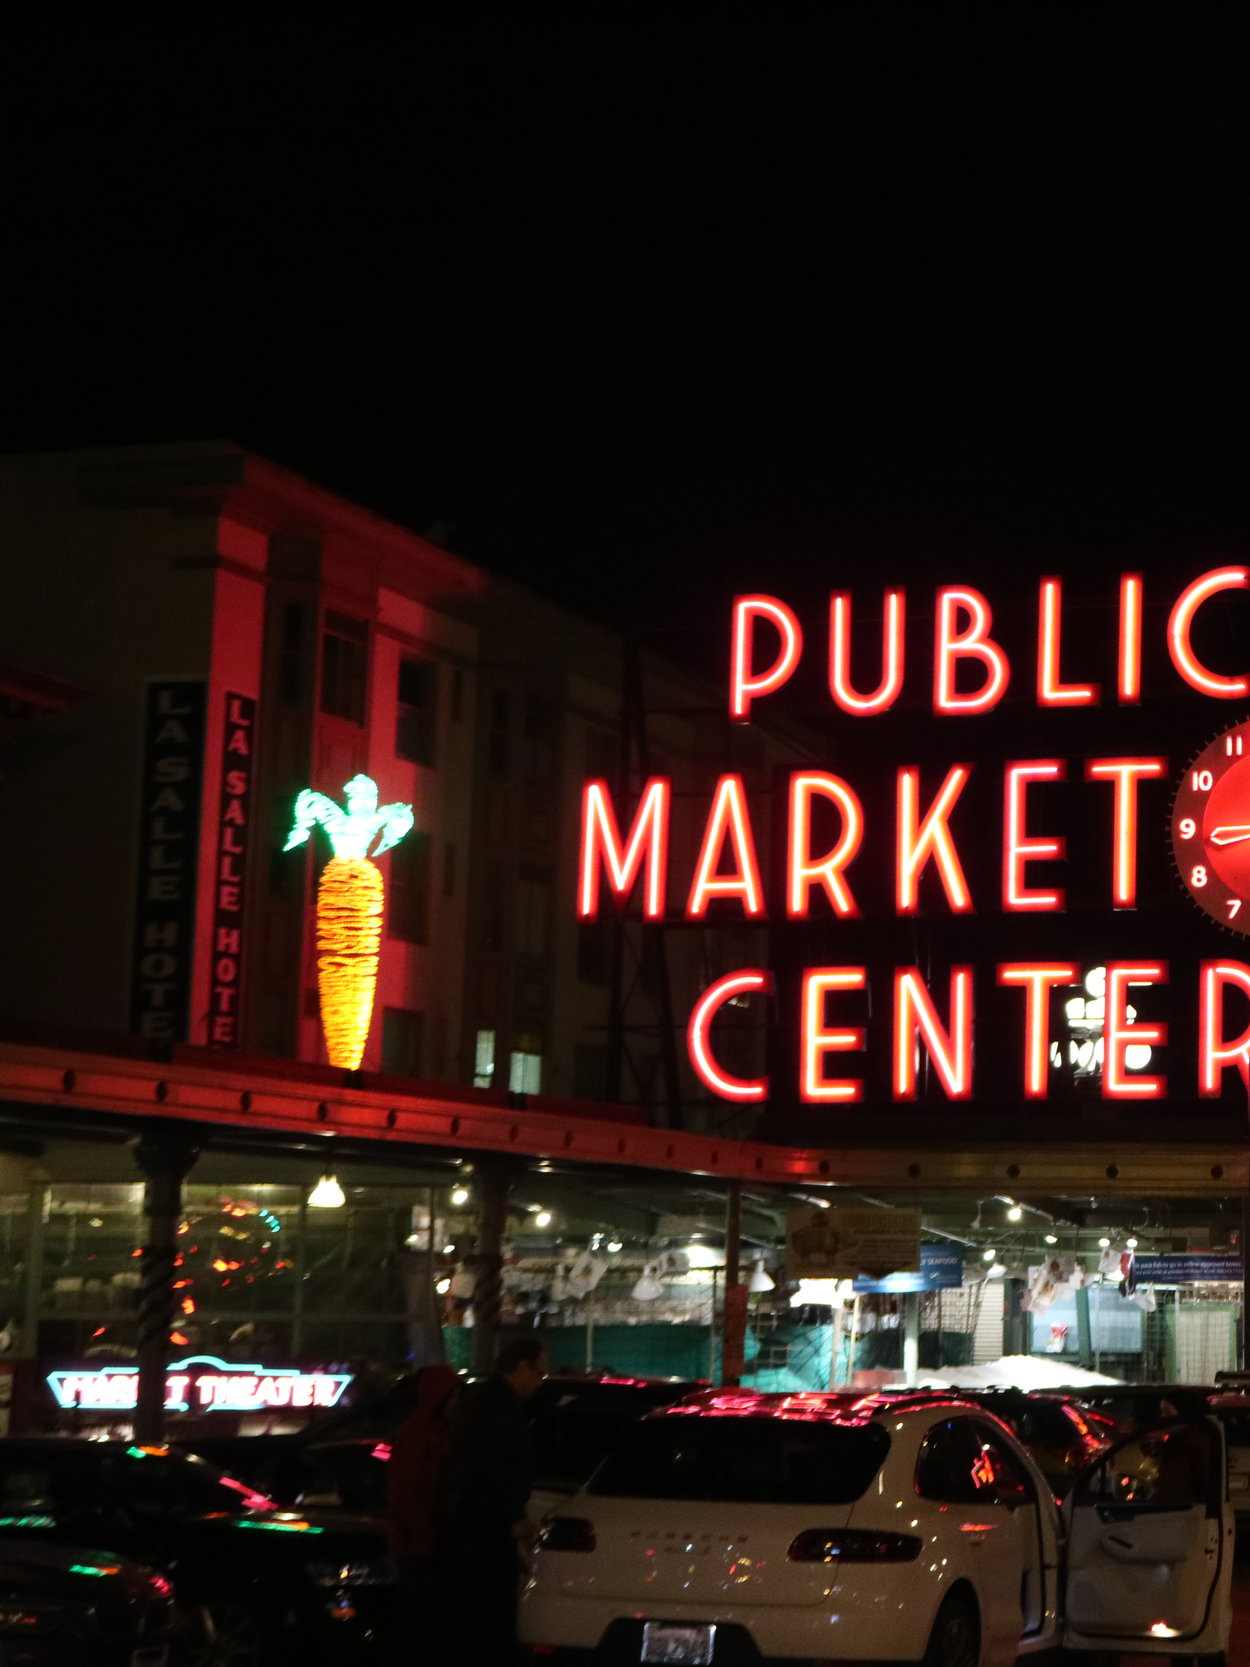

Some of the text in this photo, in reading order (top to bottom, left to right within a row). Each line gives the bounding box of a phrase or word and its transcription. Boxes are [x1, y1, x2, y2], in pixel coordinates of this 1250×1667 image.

[153, 688, 192, 744] LA
[226, 699, 251, 756] LA
[1226, 735, 1243, 756] 11
[1192, 770, 1213, 792] 10
[146, 755, 193, 902] SALLE
[219, 771, 247, 912] SALLE
[576, 757, 1169, 923] MARKET
[1179, 818, 1196, 840] 9
[1190, 865, 1208, 888] 8
[1226, 899, 1242, 919] 7
[61, 1375, 335, 1407] MART THEATER
